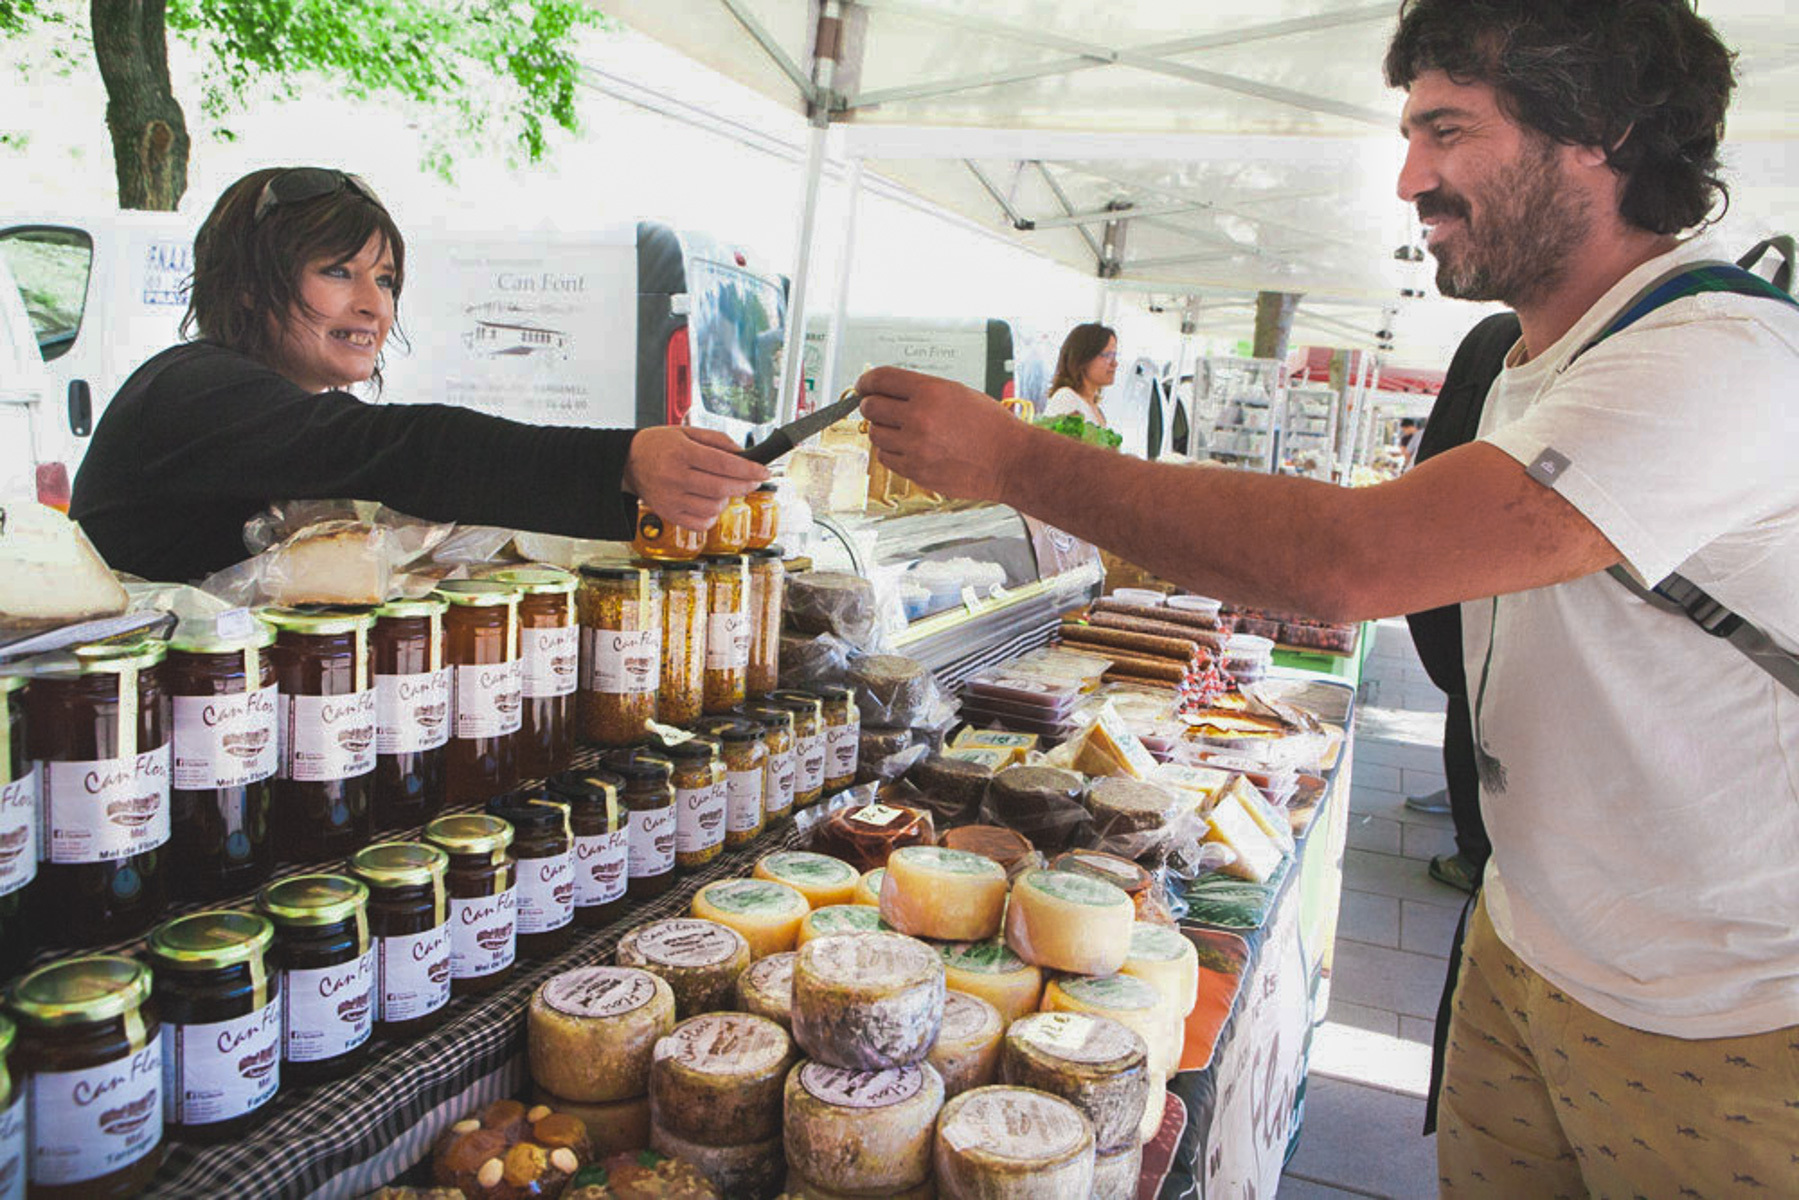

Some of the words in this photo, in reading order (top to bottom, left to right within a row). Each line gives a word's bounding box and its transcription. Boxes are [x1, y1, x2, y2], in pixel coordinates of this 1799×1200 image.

[497, 272, 535, 291] Can
[541, 272, 586, 292] Font
[903, 345, 927, 357] Can
[613, 635, 638, 652] Can
[480, 672, 508, 689] Can
[399, 682, 429, 701] Can
[202, 704, 243, 727] Can
[321, 703, 355, 724] Can
[84, 770, 130, 795] Can
[642, 815, 667, 833] Can
[99, 848, 120, 860] Mel
[577, 842, 606, 860] Can
[539, 863, 567, 883] Can
[461, 906, 494, 926] Can
[412, 937, 442, 962] Can
[318, 974, 356, 998] Can
[217, 1025, 259, 1054] Can
[73, 1079, 126, 1108] Can
